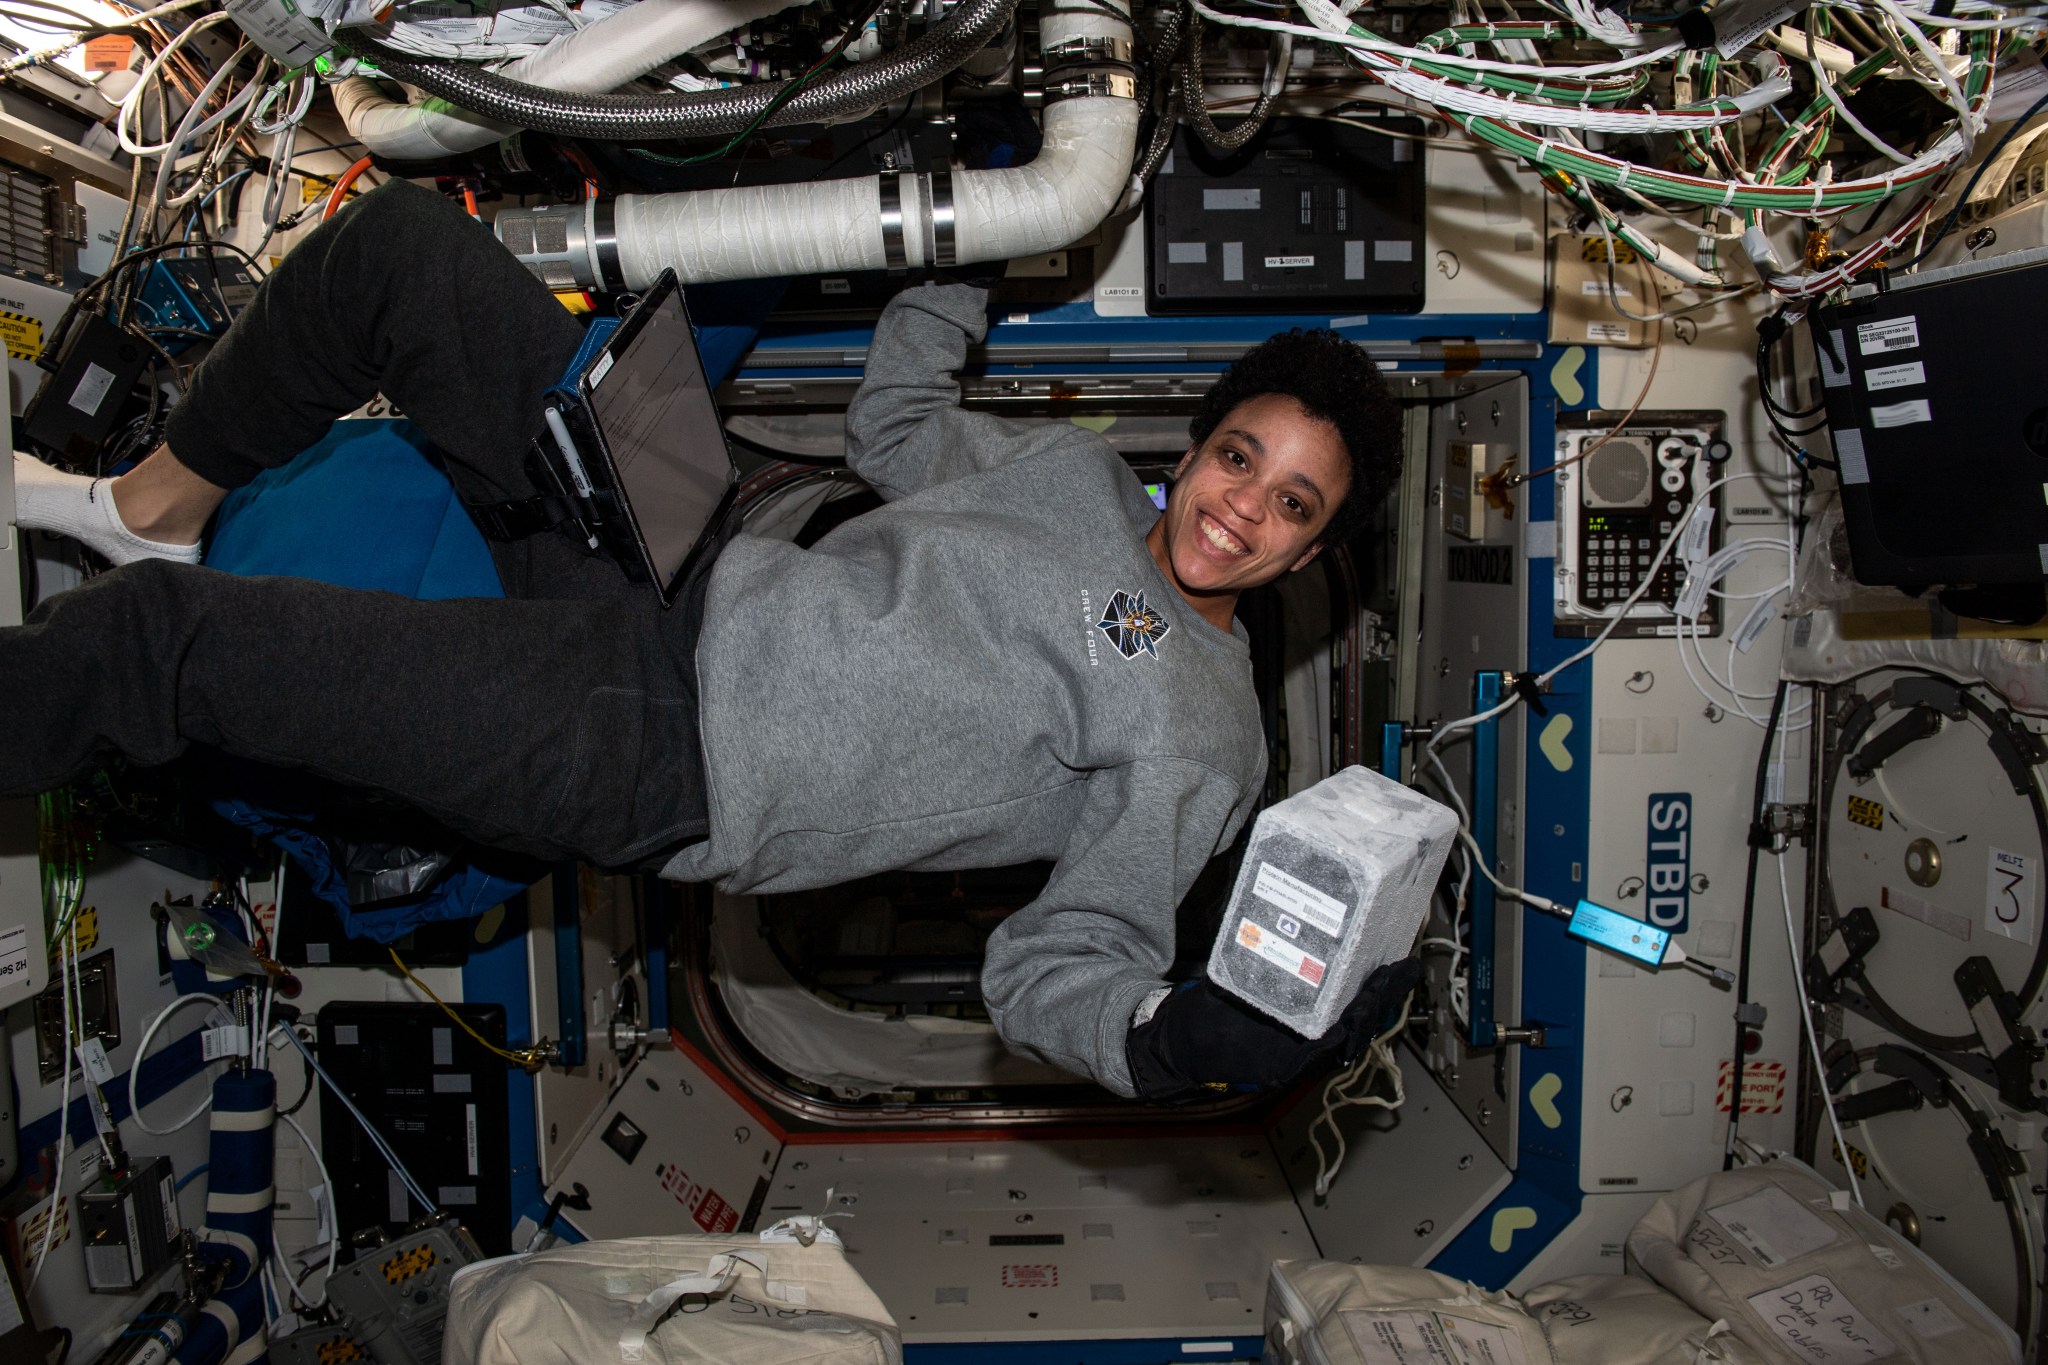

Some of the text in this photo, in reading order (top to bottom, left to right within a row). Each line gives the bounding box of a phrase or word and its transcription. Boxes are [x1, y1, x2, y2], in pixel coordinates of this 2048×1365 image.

[1722, 24, 1748, 45] EXPRESS
[1729, 29, 1750, 46] Jumper
[1743, 31, 1755, 42] VDC
[1756, 21, 1770, 32] Load
[8, 300, 24, 310] INLET
[0, 321, 26, 334] CAUTION
[1449, 549, 1512, 580] TO NOD 2
[1081, 590, 1098, 666] CREW FOUR
[1650, 801, 1688, 926] STBD
[1997, 853, 2024, 868] MELFI
[1261, 867, 1281, 881] Protein
[1282, 877, 1322, 903] Manufacturing
[1996, 867, 2023, 923] 3
[15, 959, 27, 972] H2
[1727, 1084, 1776, 1092] FE PORT
[700, 1195, 721, 1224] WATER
[720, 1204, 734, 1221] PFE
[29, 1231, 44, 1244] FIRE
[1780, 1291, 1818, 1328] Data
[1808, 1285, 1833, 1309] RR
[1832, 1315, 1870, 1344] Pwr
[1418, 1325, 1432, 1344] VELCRO
[1776, 1314, 1831, 1360] Cables
[145, 1348, 158, 1361] Only
